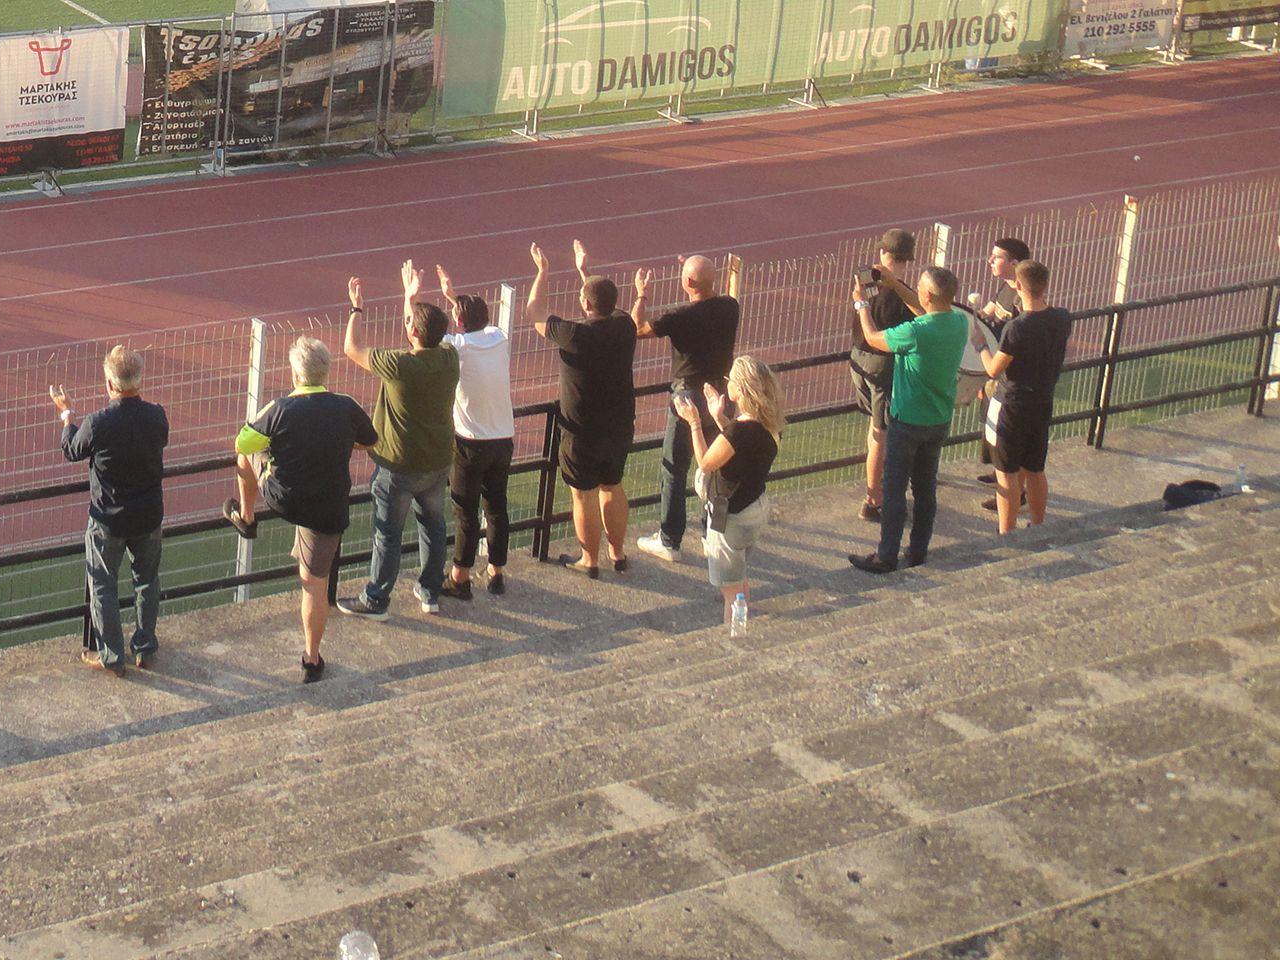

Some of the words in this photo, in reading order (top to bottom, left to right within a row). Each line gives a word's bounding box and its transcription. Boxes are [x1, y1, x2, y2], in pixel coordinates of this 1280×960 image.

[819, 25, 892, 63] AUTO
[894, 11, 1018, 55] DAMIGOS
[1084, 25, 1104, 38] 210
[1105, 23, 1125, 36] 292
[1127, 20, 1156, 33] 5555
[502, 59, 593, 101] AUTO
[597, 43, 736, 93] DAMIGOS
[19, 80, 77, 95] ΜΑΡΤΑΚΗΣ
[18, 91, 78, 106] ΤΣΕΚΟΥΡΑΣ
[151, 141, 198, 152] Εσκευή
